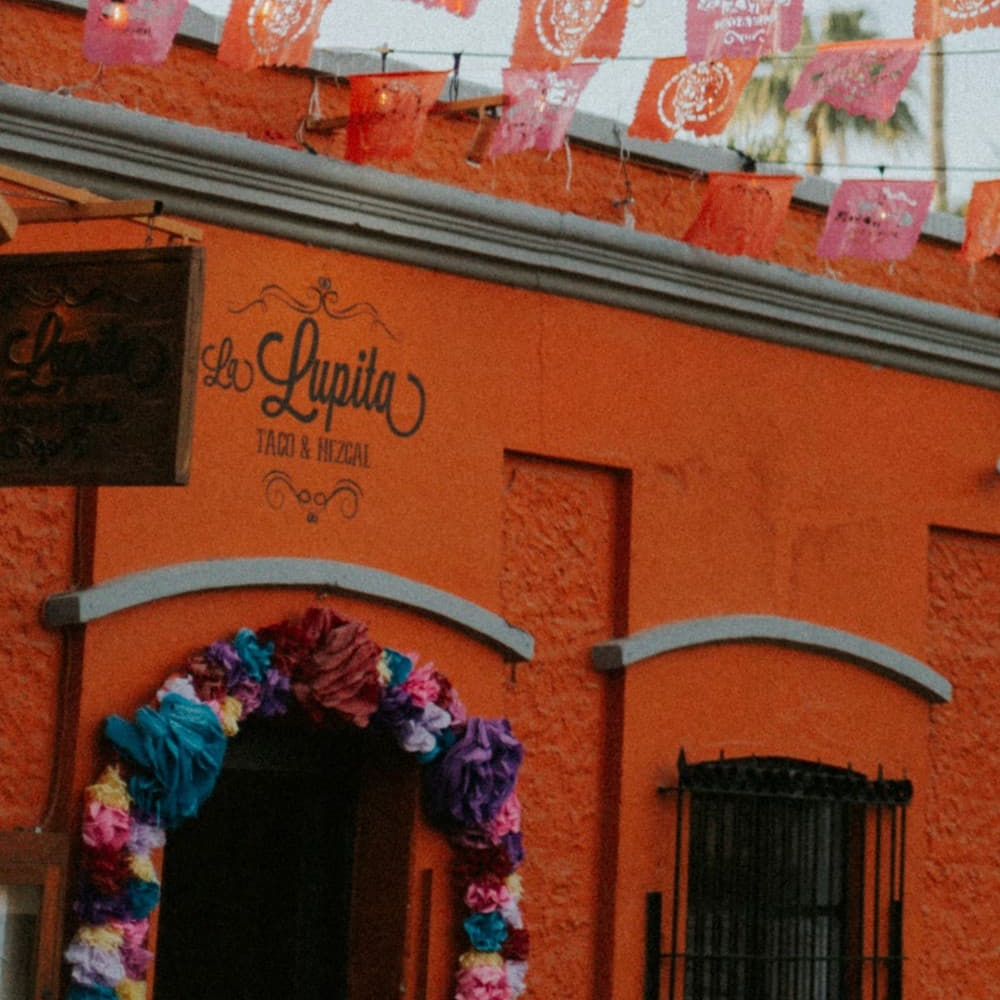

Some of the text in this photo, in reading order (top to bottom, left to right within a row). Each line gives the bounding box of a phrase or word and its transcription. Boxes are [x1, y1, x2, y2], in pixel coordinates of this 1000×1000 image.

[201, 337, 254, 392] La
[257, 317, 425, 437] Lupita
[257, 428, 370, 469] TACO & MEZCAL
